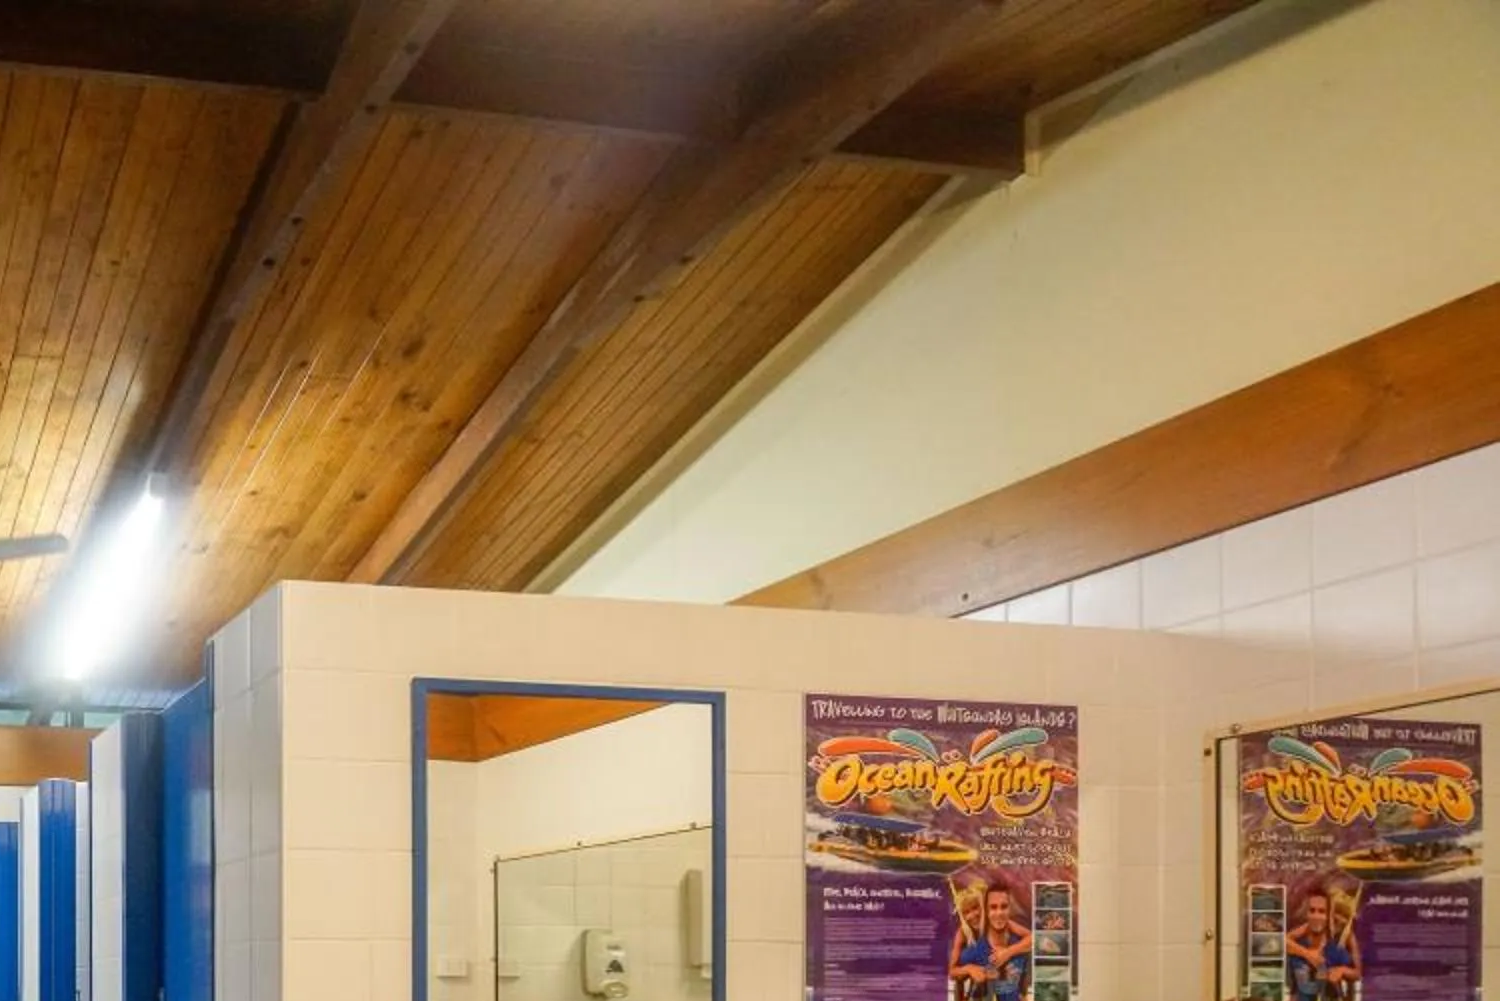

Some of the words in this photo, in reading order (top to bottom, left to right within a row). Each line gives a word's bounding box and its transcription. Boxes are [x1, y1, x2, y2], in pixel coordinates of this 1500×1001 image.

[890, 706, 907, 719] TO
[816, 753, 935, 808] Ocean
[931, 754, 1056, 820] Rafting
